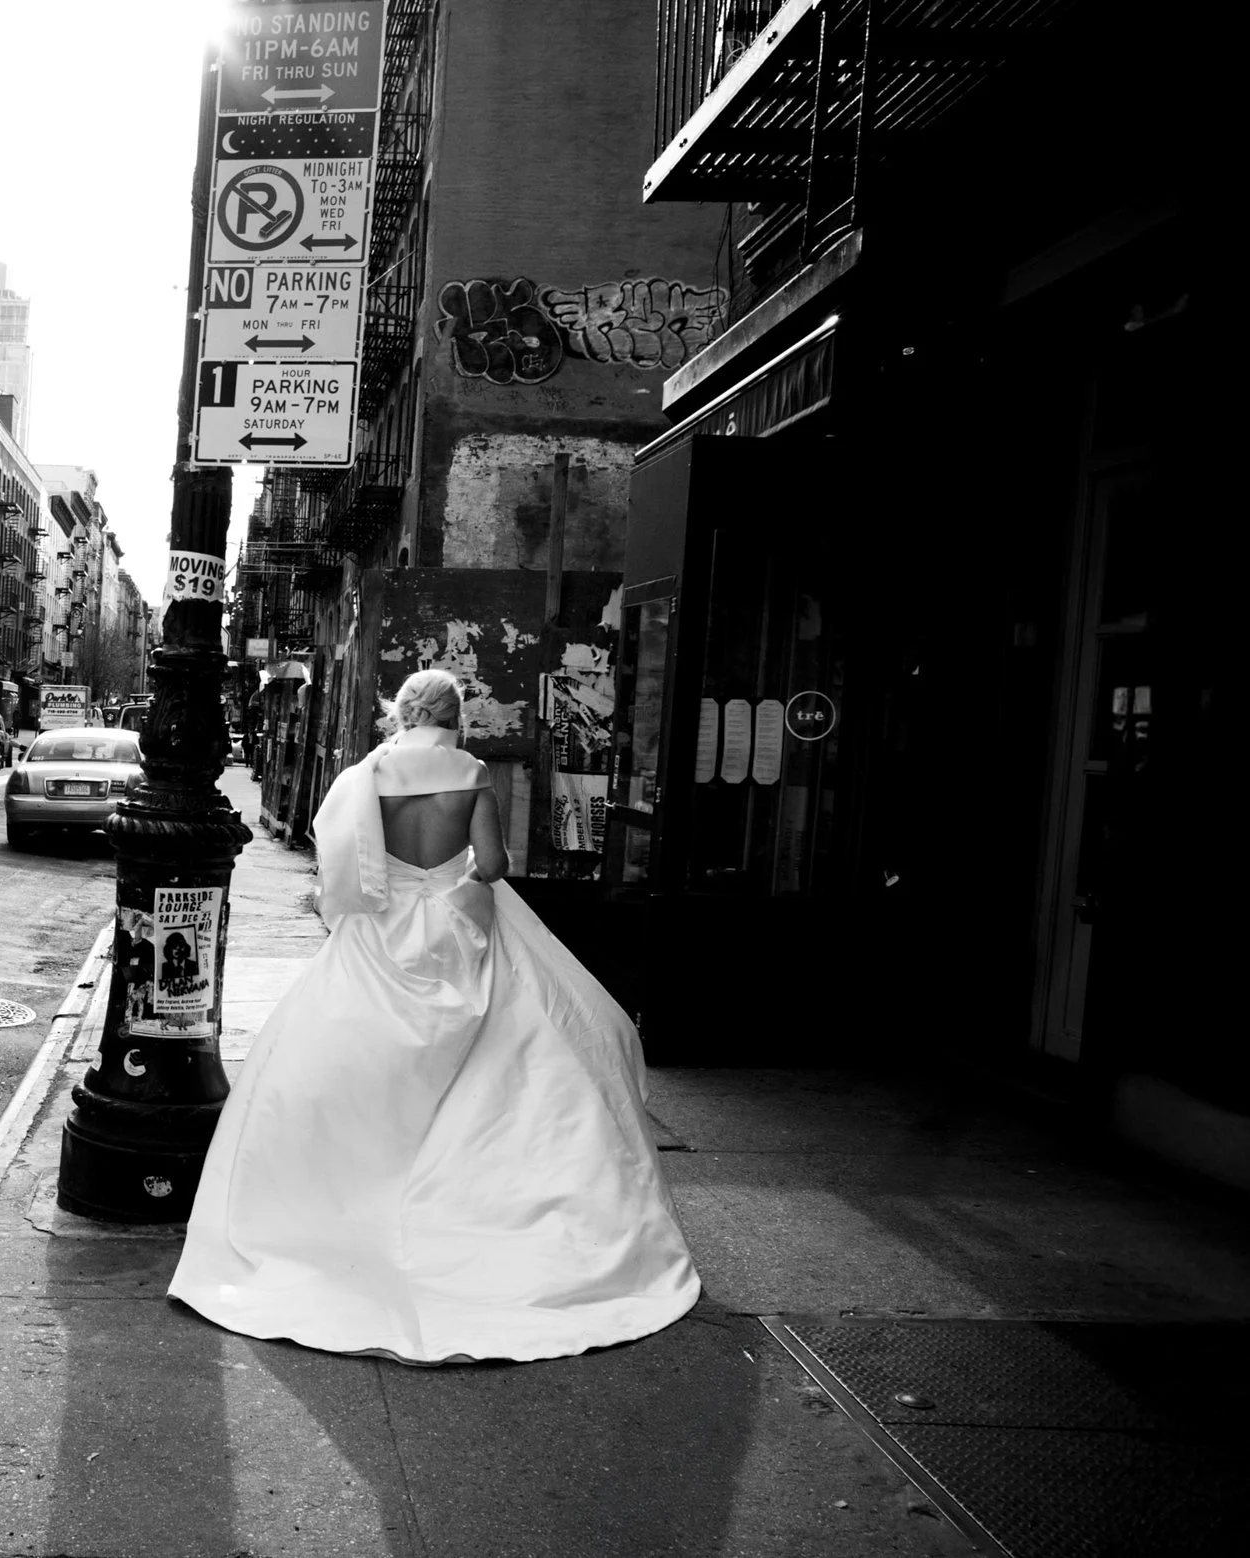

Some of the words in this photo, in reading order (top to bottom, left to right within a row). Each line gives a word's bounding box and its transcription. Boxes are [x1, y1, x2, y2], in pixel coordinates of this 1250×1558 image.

[236, 16, 262, 36] NO
[271, 11, 370, 35] STANDING
[242, 66, 269, 81] FRI
[276, 65, 315, 79] THRU
[322, 62, 358, 78] SUN
[237, 114, 273, 126] NIGHT
[279, 113, 356, 125] REGULATION
[303, 161, 364, 177] MIDNIGHT
[320, 195, 346, 206] MON
[320, 208, 345, 219] WED
[322, 220, 341, 231] FRI
[209, 269, 250, 303] NO
[266, 271, 352, 291] PARKING
[243, 320, 268, 330] MON
[301, 320, 321, 330] FRI
[282, 370, 311, 378] HOUR
[212, 366, 223, 404] 1
[252, 379, 340, 394] PARKING
[244, 419, 305, 430] SATURDAY
[170, 556, 225, 580] MOVING
[173, 574, 215, 596] $19
[590, 796, 605, 837] HORSES
[159, 891, 213, 903] PARKSIDE
[158, 902, 203, 913] LOUNGE
[159, 915, 178, 923] SAT
[182, 914, 198, 923] DEC
